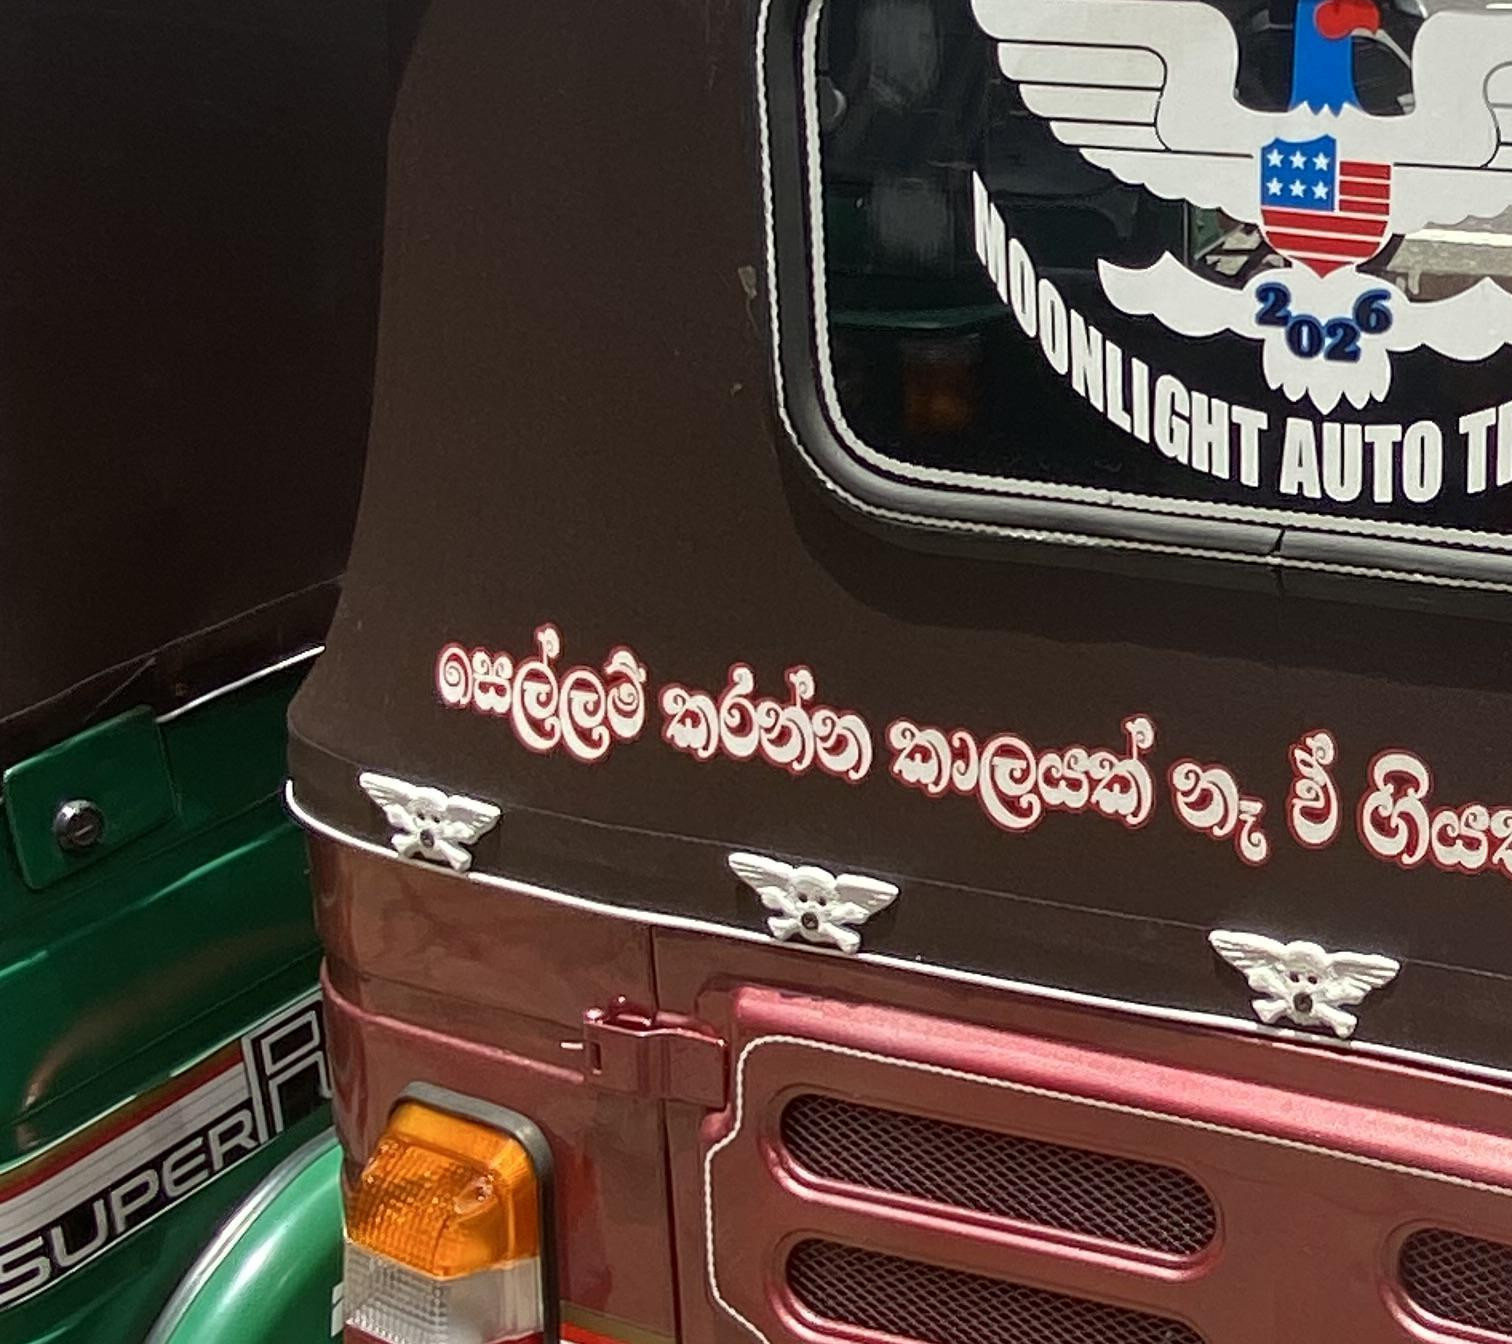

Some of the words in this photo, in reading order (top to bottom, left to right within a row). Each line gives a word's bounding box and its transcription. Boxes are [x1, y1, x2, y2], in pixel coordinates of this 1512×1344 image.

[971, 168, 1269, 488] MOONLIGHT
[1279, 417, 1444, 504] AUTO
[1255, 282, 1393, 362] 2026
[436, 625, 649, 763] සෙල්ලම්
[660, 664, 875, 783] කරන්න
[887, 715, 1157, 831] කාලයක්
[1170, 760, 1270, 864] නෑ
[0, 1108, 259, 1308] SUPER
